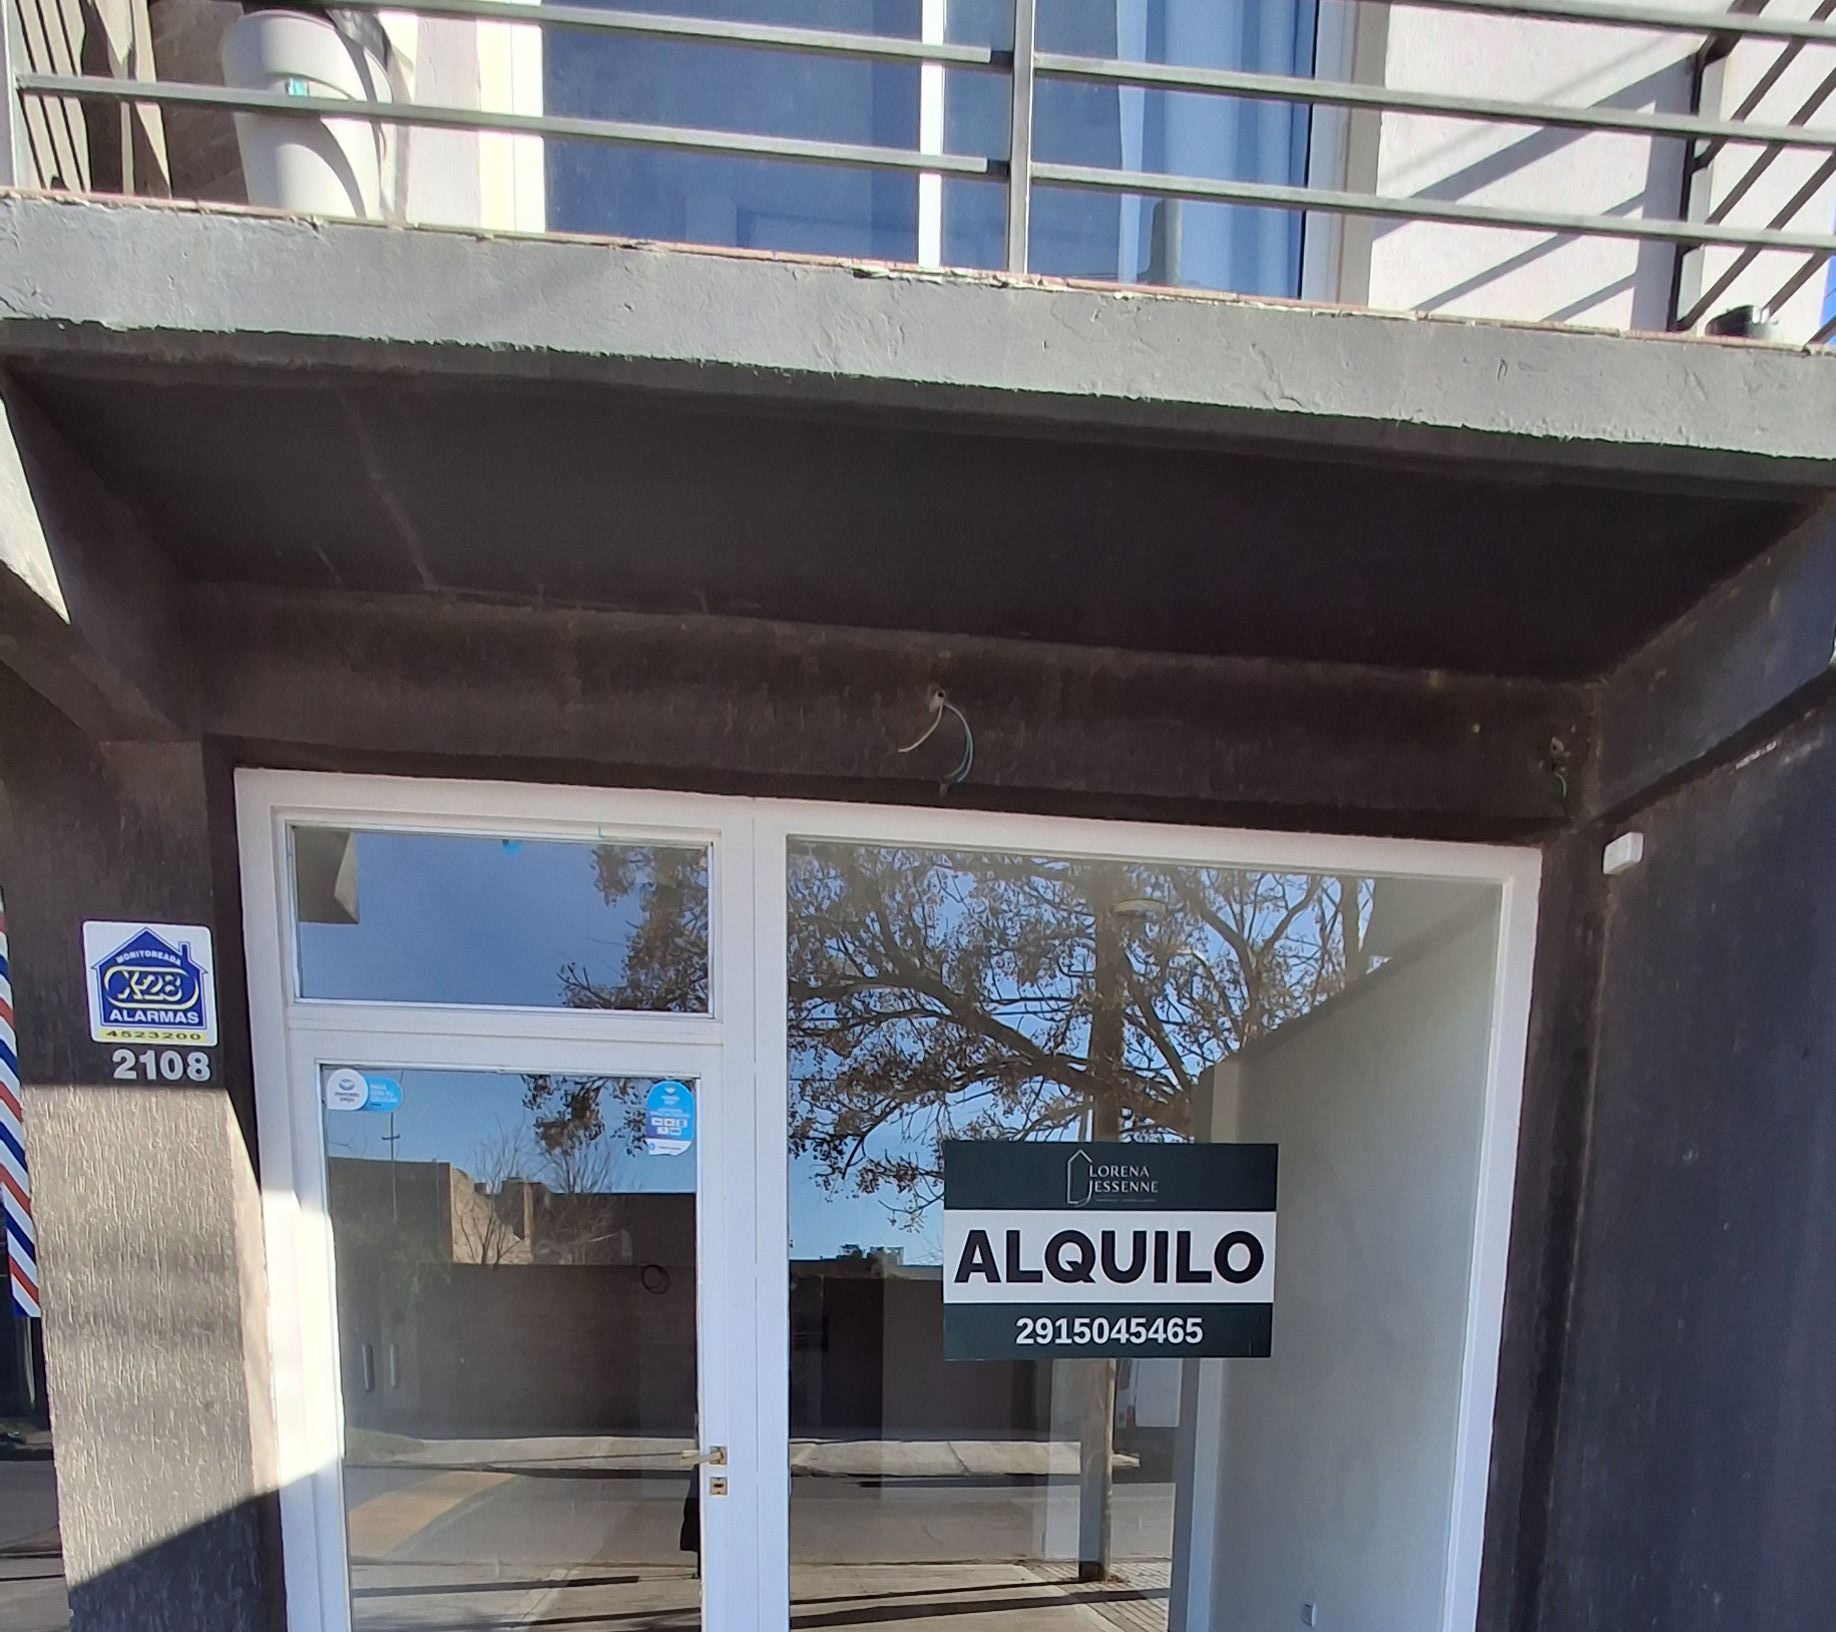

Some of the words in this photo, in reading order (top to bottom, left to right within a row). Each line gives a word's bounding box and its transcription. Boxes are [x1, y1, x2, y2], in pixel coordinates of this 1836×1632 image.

[115, 949, 182, 967] MONITOREADA
[109, 1008, 200, 1025] ALARMAS
[106, 1030, 202, 1041] 4523200
[112, 1048, 212, 1082] 2108
[1089, 1164, 1150, 1178] LORENA
[1086, 1180, 1159, 1195] JESSENNE
[953, 1228, 1266, 1285] ALQUILO
[1015, 1316, 1205, 1346] 2915045465
